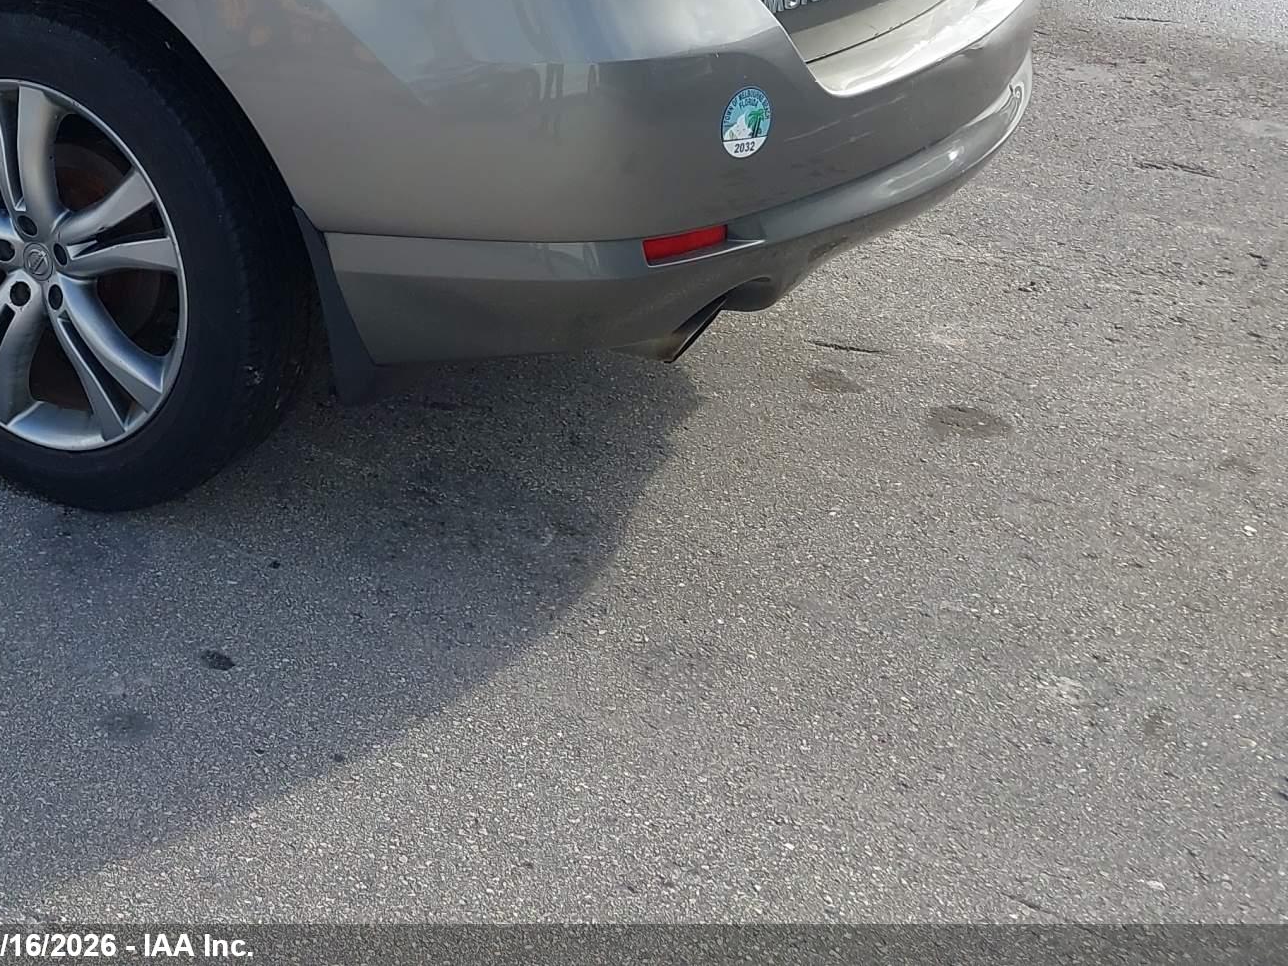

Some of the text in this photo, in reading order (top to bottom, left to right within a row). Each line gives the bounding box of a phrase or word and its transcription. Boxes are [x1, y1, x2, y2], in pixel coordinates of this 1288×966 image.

[739, 97, 758, 108] FLORIDA
[724, 106, 734, 123] TOWN
[734, 141, 755, 153] 2032
